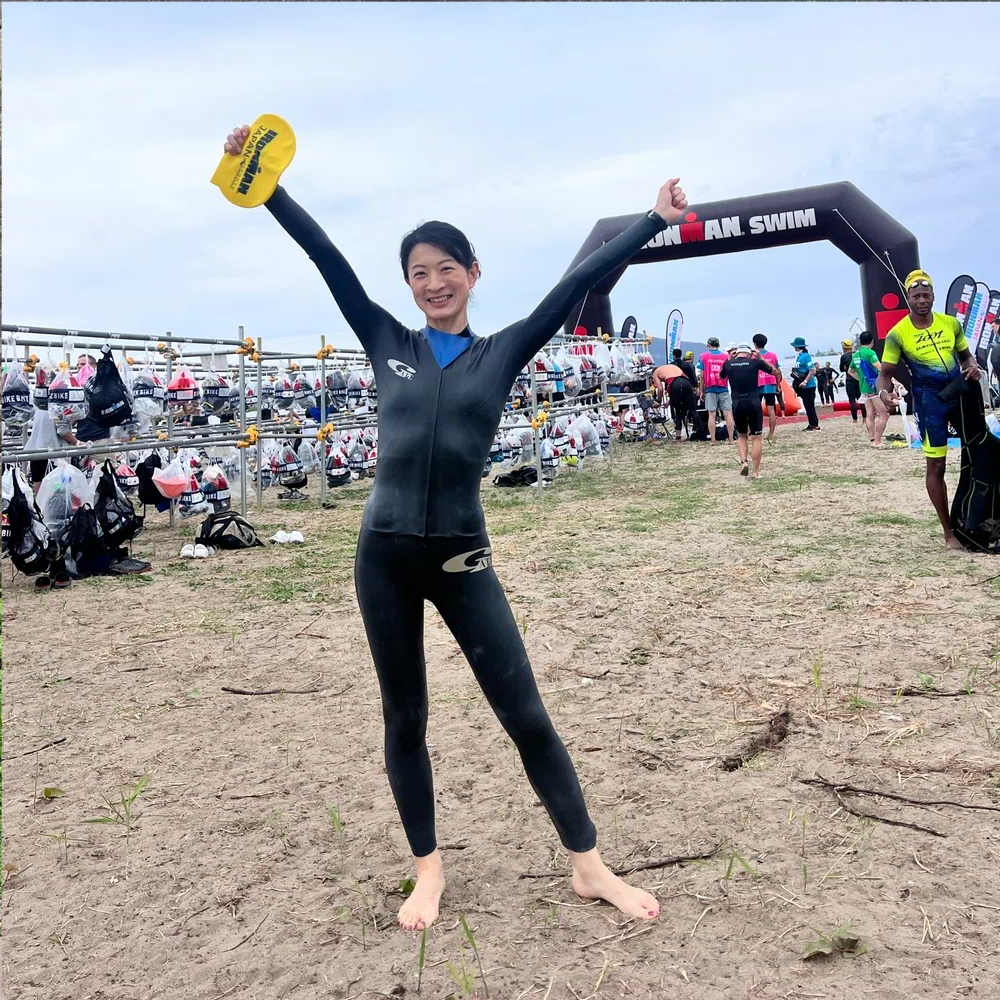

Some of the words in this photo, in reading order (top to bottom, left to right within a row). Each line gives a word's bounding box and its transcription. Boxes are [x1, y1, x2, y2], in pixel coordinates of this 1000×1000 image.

[243, 125, 267, 158] JAPAN
[236, 129, 278, 196] IRONMAN
[749, 208, 817, 235] SWIM
